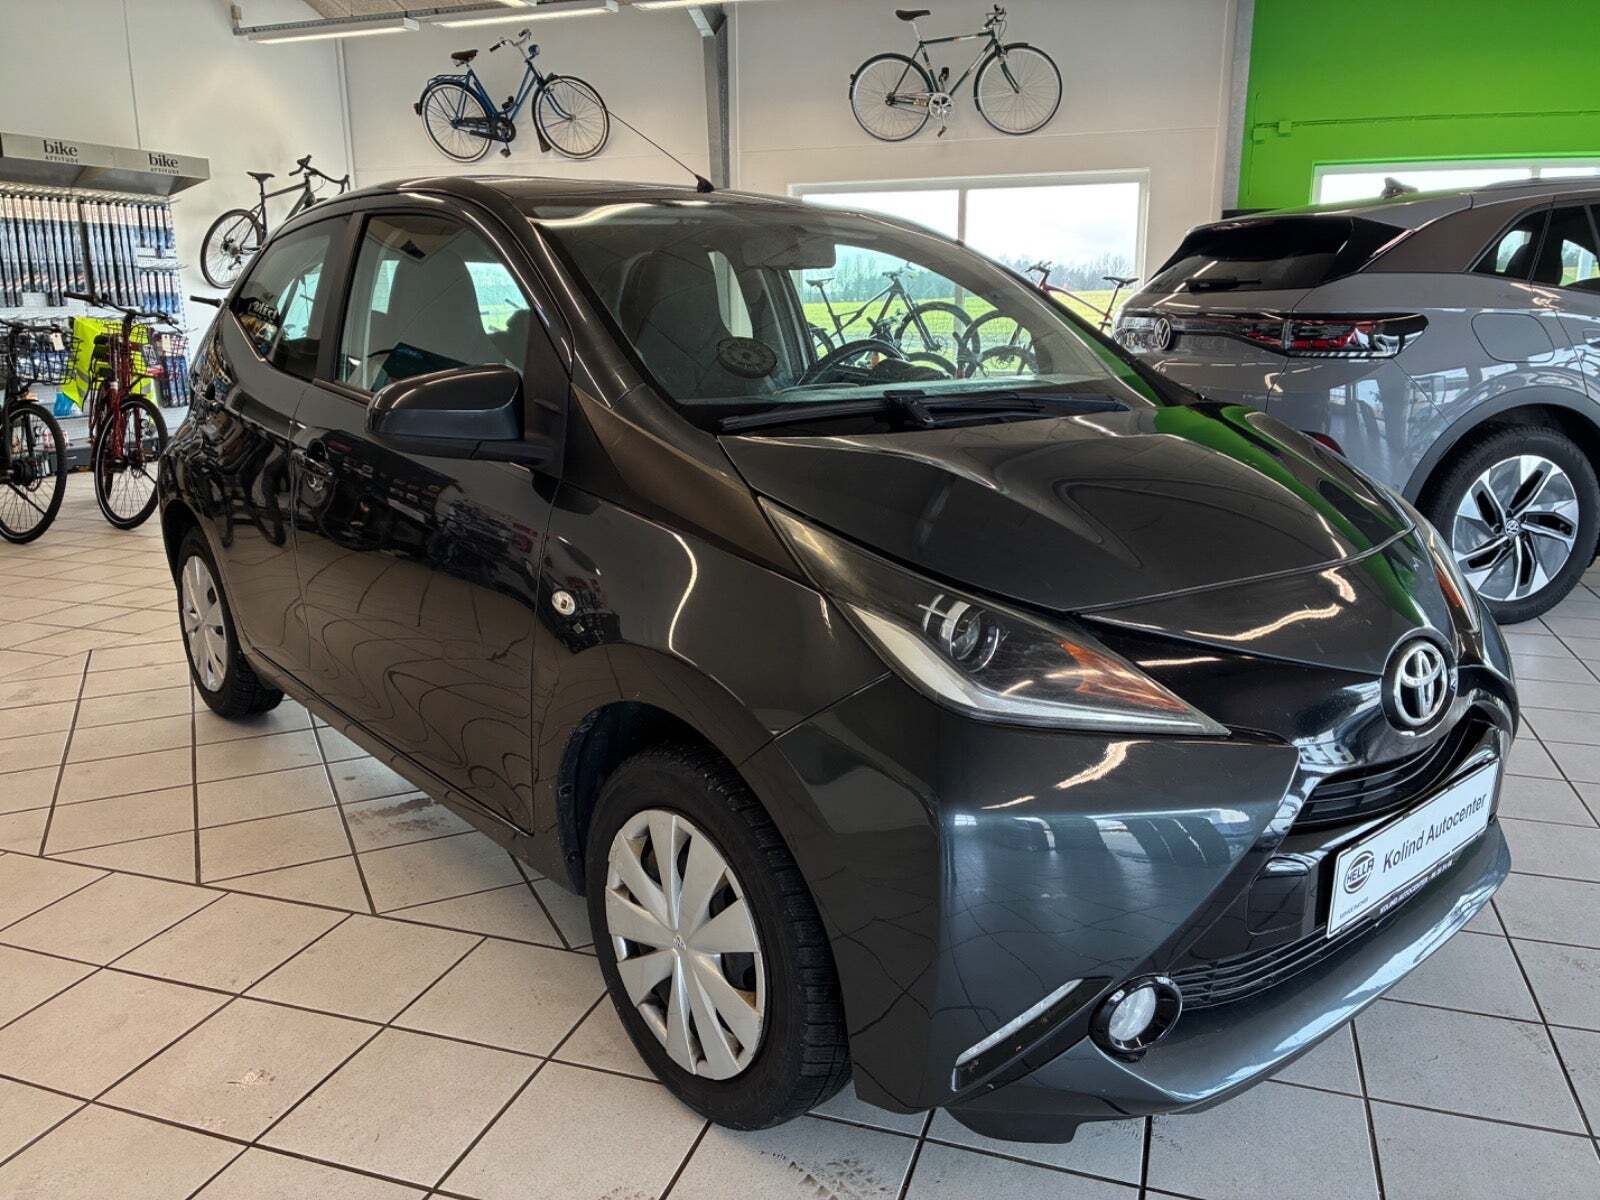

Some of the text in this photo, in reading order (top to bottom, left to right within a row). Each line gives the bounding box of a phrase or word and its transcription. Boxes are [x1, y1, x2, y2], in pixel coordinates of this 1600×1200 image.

[43, 139, 78, 157] bike
[148, 153, 179, 168] bike
[1382, 793, 1487, 872] Kolind Autocenter
[1346, 857, 1375, 884] HELLA
